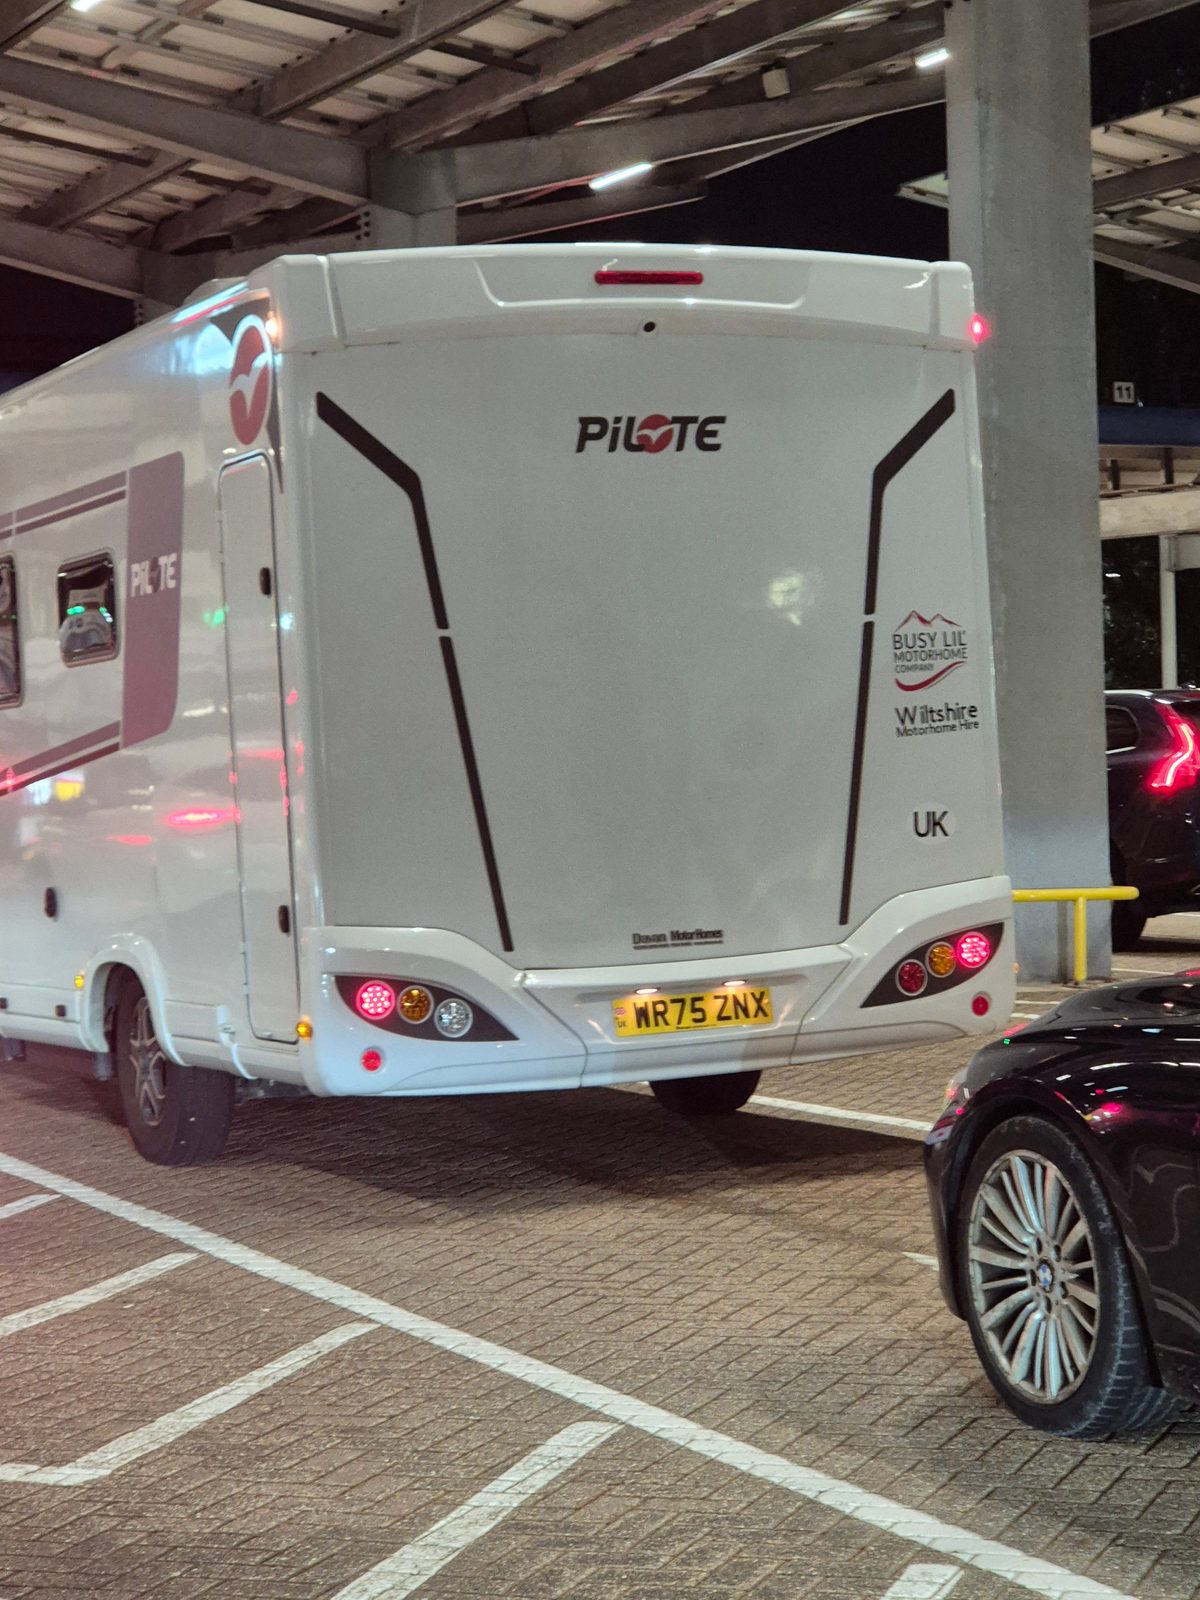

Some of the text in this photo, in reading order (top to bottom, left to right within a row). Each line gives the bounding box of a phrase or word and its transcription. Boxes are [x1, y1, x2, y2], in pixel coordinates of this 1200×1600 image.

[1116, 384, 1132, 400] 11
[893, 633, 937, 650] BUSY
[894, 648, 968, 663] MOTORHOME
[895, 664, 934, 673] COMPANY
[894, 702, 979, 727] Wiltshire
[896, 719, 980, 738] Motorhome Hire
[913, 810, 949, 838] UK
[633, 991, 769, 1029] WR75 ZNX
